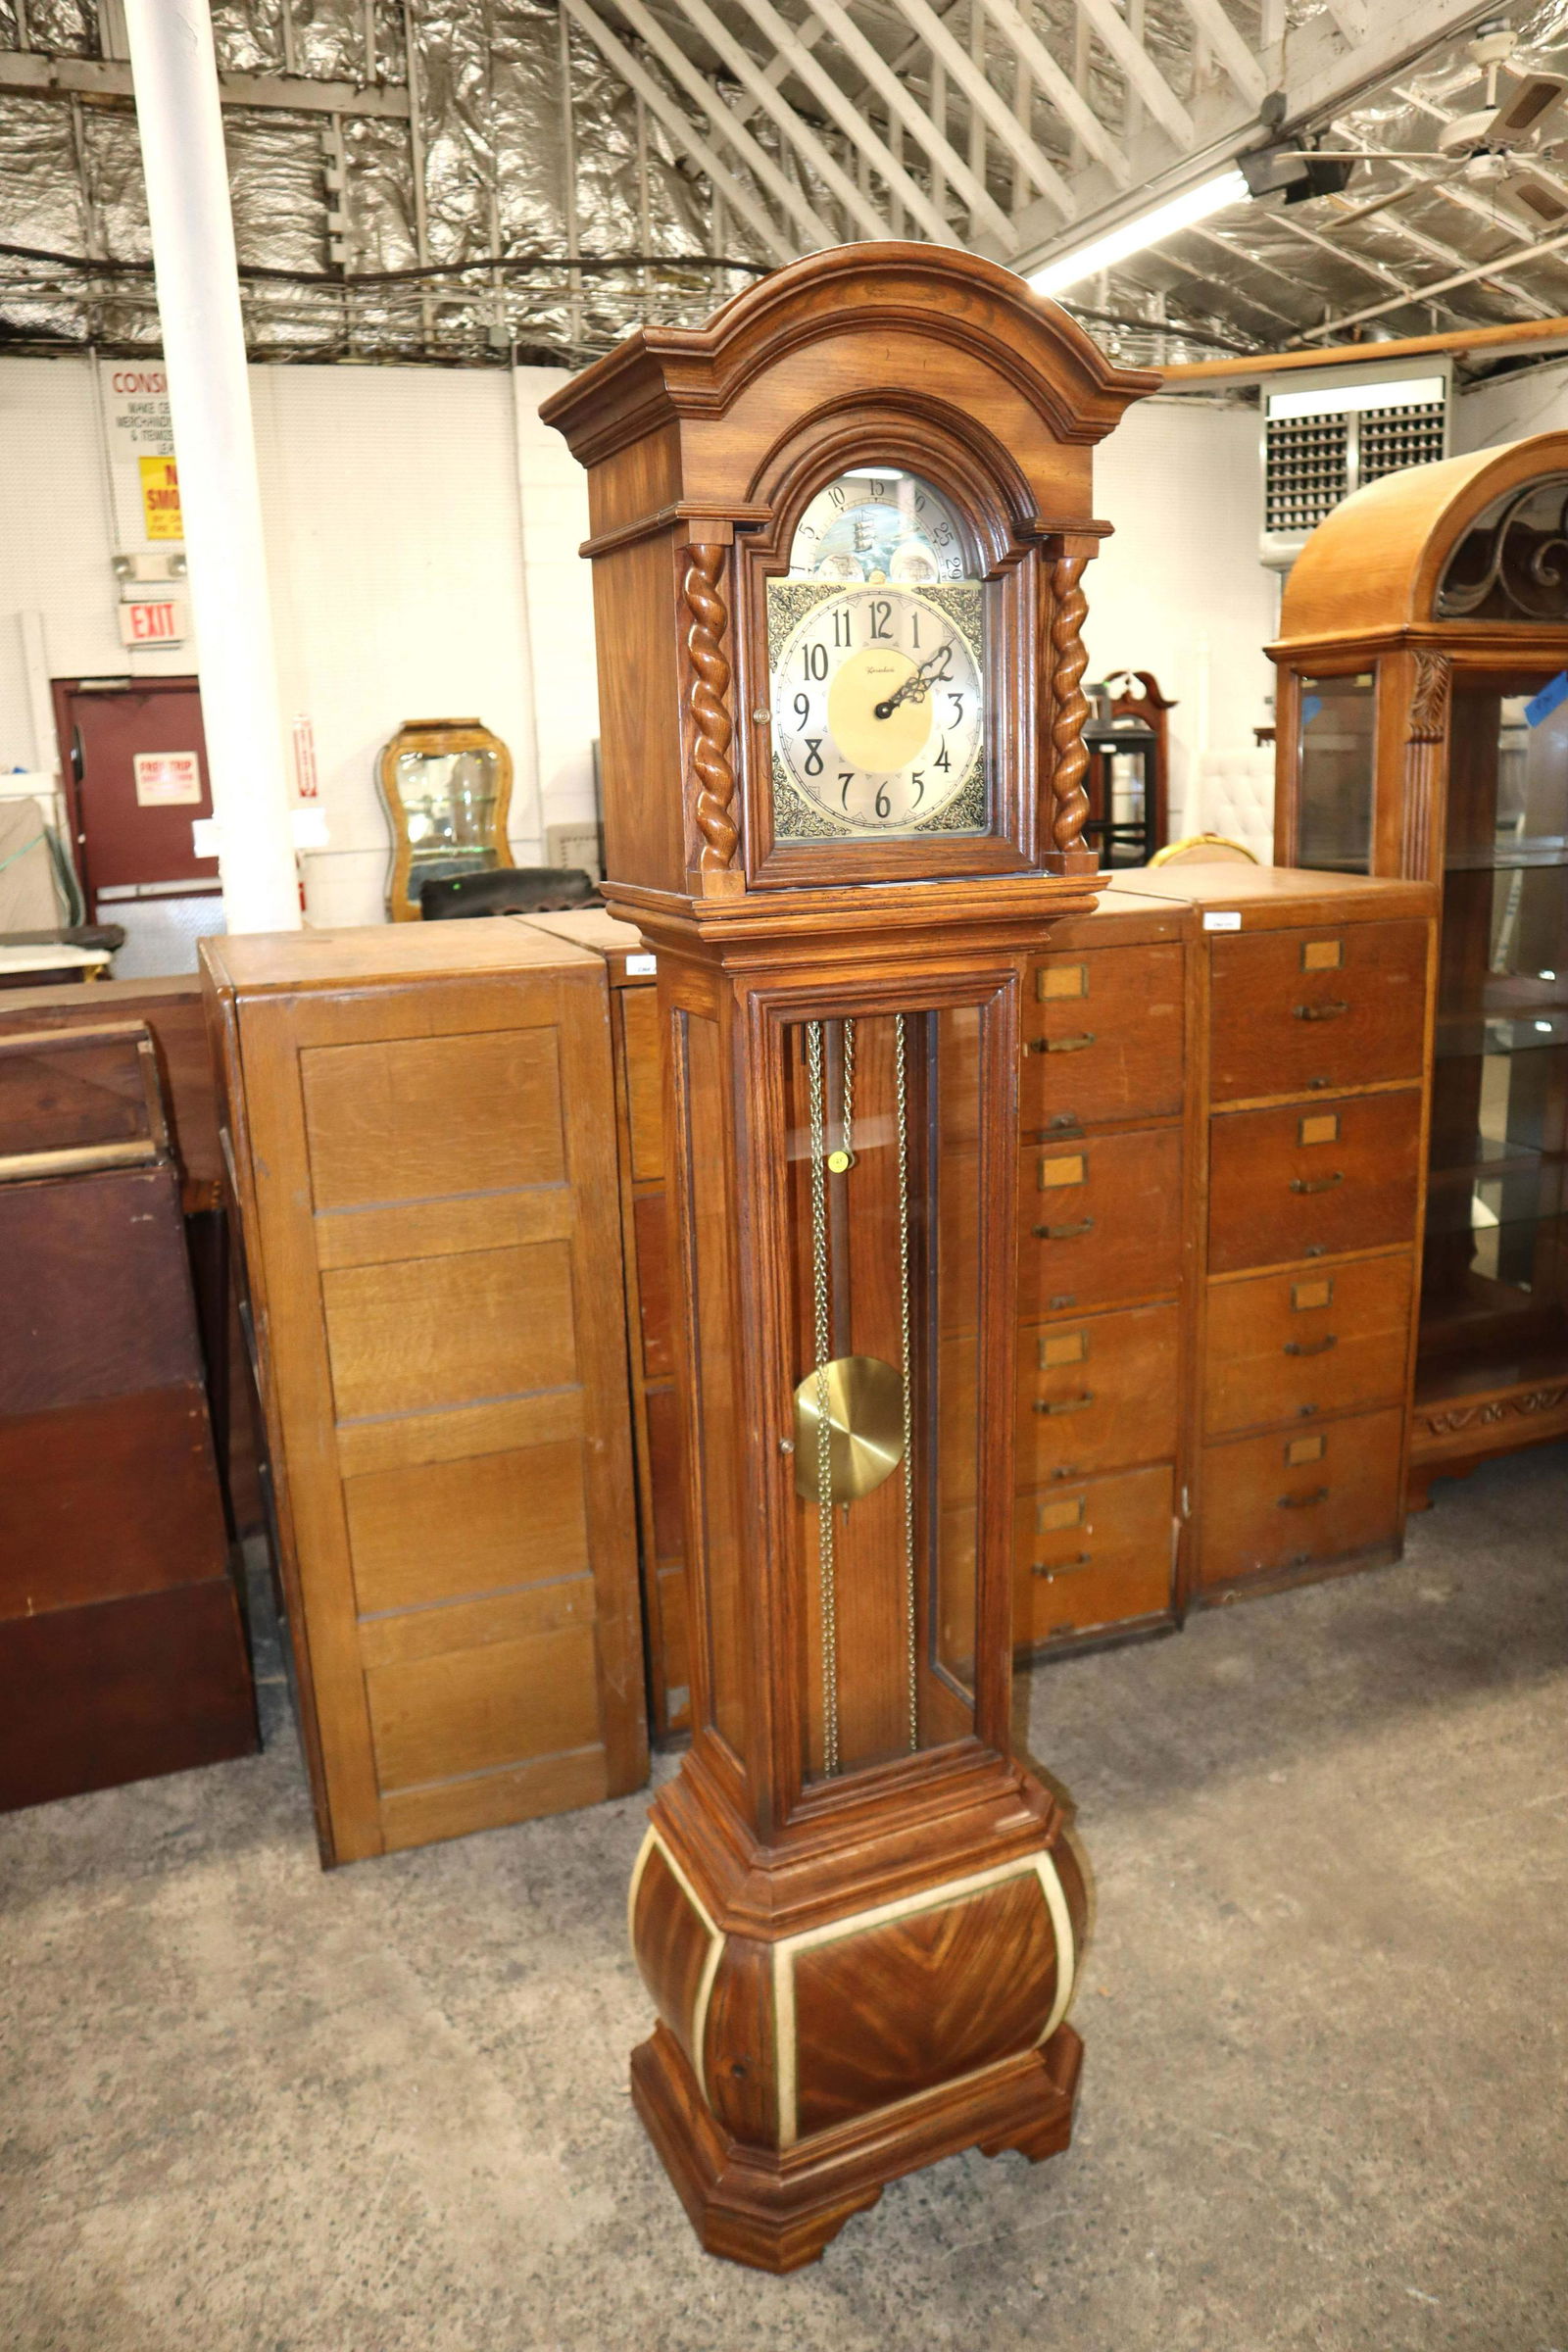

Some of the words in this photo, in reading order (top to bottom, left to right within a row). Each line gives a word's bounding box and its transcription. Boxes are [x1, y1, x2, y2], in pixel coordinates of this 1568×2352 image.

[828, 486, 846, 509] 10
[869, 479, 885, 497] 15
[798, 522, 815, 540] 5
[932, 521, 954, 547] 25
[945, 557, 962, 580] 29
[129, 603, 174, 639] EXIT
[832, 609, 852, 647] 11
[868, 601, 894, 639] 12
[911, 612, 920, 649] 1
[802, 643, 829, 681] 10
[938, 645, 955, 681] 2
[794, 693, 809, 732] 9
[948, 693, 964, 730] 3
[804, 739, 824, 776] 8
[933, 734, 952, 773] 4
[838, 773, 856, 811] 7
[875, 780, 891, 818] 6
[911, 770, 925, 809] 5
